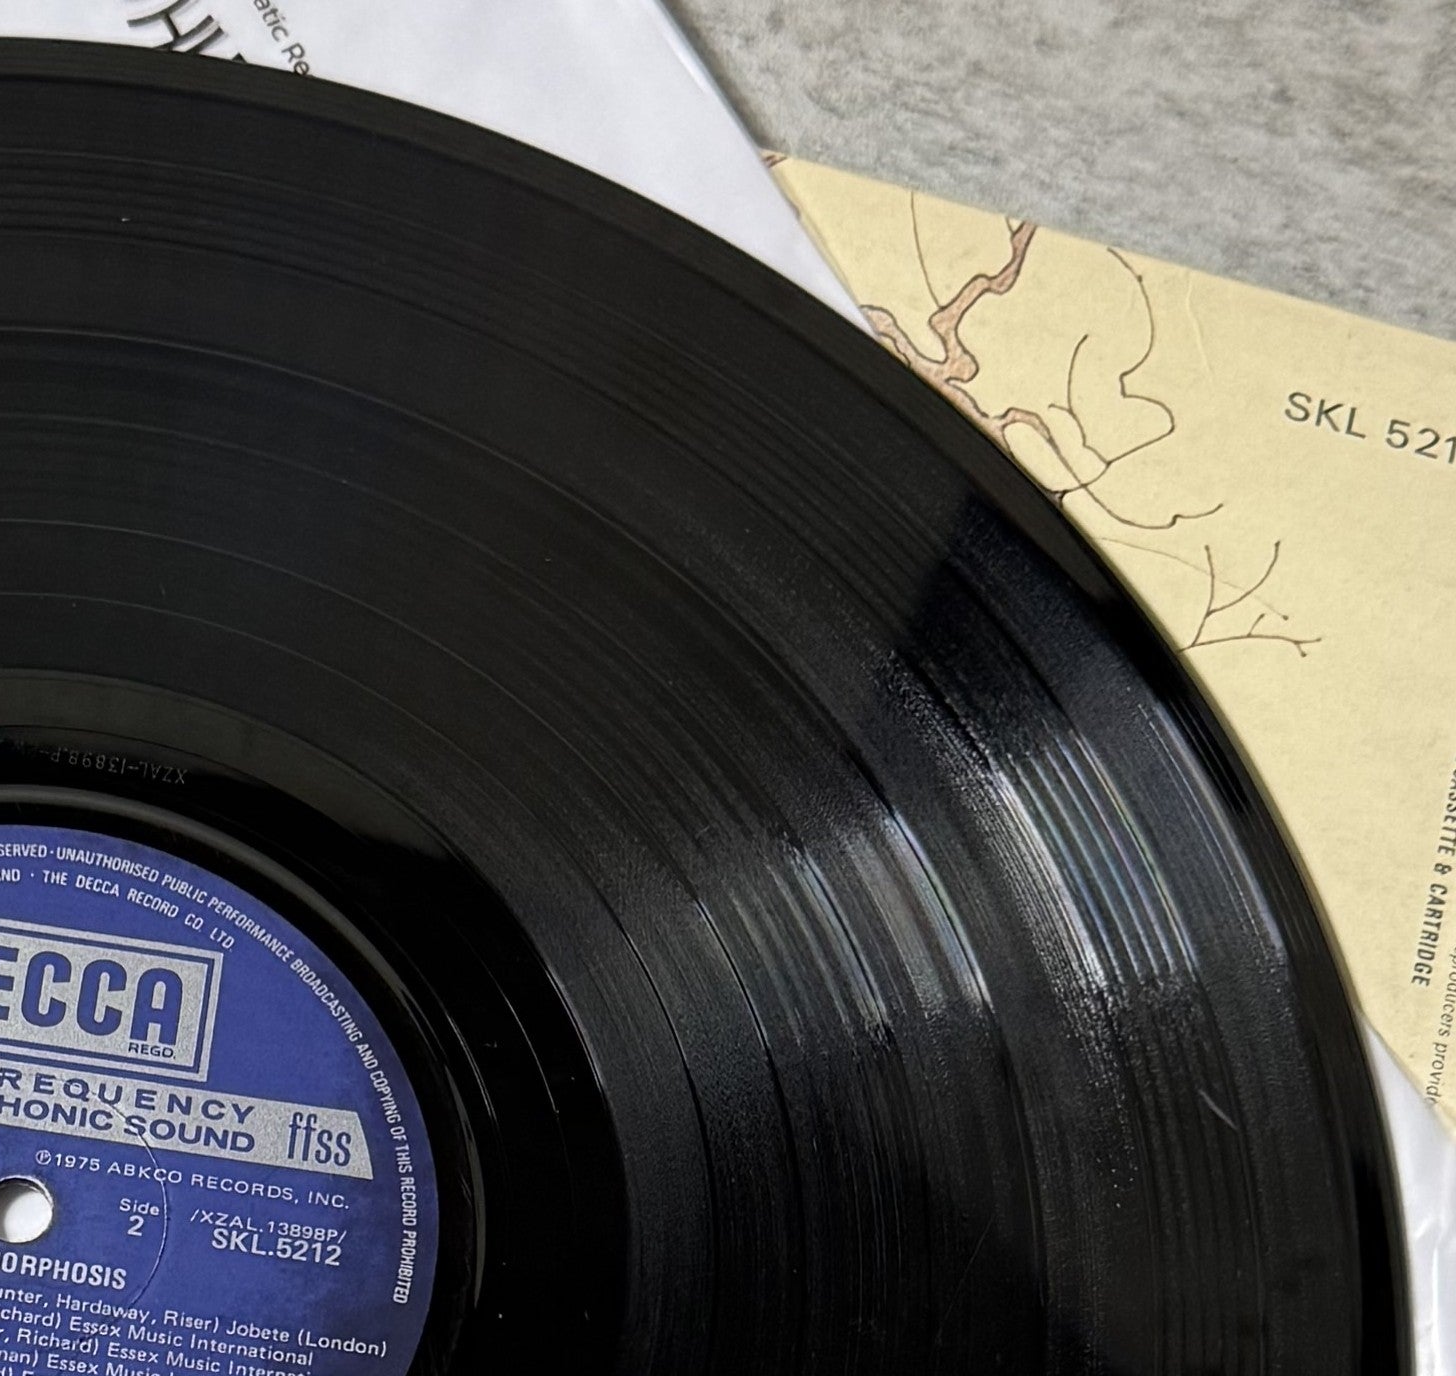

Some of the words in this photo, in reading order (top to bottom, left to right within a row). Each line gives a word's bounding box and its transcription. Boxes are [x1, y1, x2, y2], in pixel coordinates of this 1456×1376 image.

[1284, 391, 1367, 439] SKL
[57, 847, 159, 882] UNAUTHORISED
[43, 870, 68, 885] THE
[75, 875, 119, 897] DECCA
[127, 888, 179, 917] RECORD
[162, 874, 207, 903] PUBLIC
[208, 897, 294, 962] PERFORMANCE
[1411, 883, 1448, 987] CARTRIDGE
[290, 959, 362, 1041] BROADCASTING
[356, 1044, 378, 1069] AND
[370, 1071, 401, 1123] COPYING
[123, 1115, 255, 1153] SOUND
[390, 1126, 406, 1140] OF
[396, 1145, 412, 1173] THIS
[107, 1162, 182, 1183] ABKCO
[191, 1174, 298, 1204] RECORDS,
[308, 1191, 348, 1209] INC.
[120, 1198, 159, 1215] Side
[401, 1177, 417, 1225] RECORD
[127, 1215, 144, 1236] 2
[211, 1228, 342, 1265] SKL.5212
[393, 1230, 416, 1303] PROHIBITED
[56, 1294, 156, 1325] Hardaway,
[164, 1310, 218, 1333] Riser)
[226, 1321, 289, 1342] Jobete
[298, 1329, 386, 1357] (London)
[70, 1316, 121, 1337] Essex
[128, 1325, 182, 1346] Music
[191, 1334, 313, 1365] International
[17, 1328, 98, 1355] Richard)
[108, 1342, 158, 1363] Essex
[166, 1351, 220, 1372] Music
[47, 1353, 98, 1374] Essex
